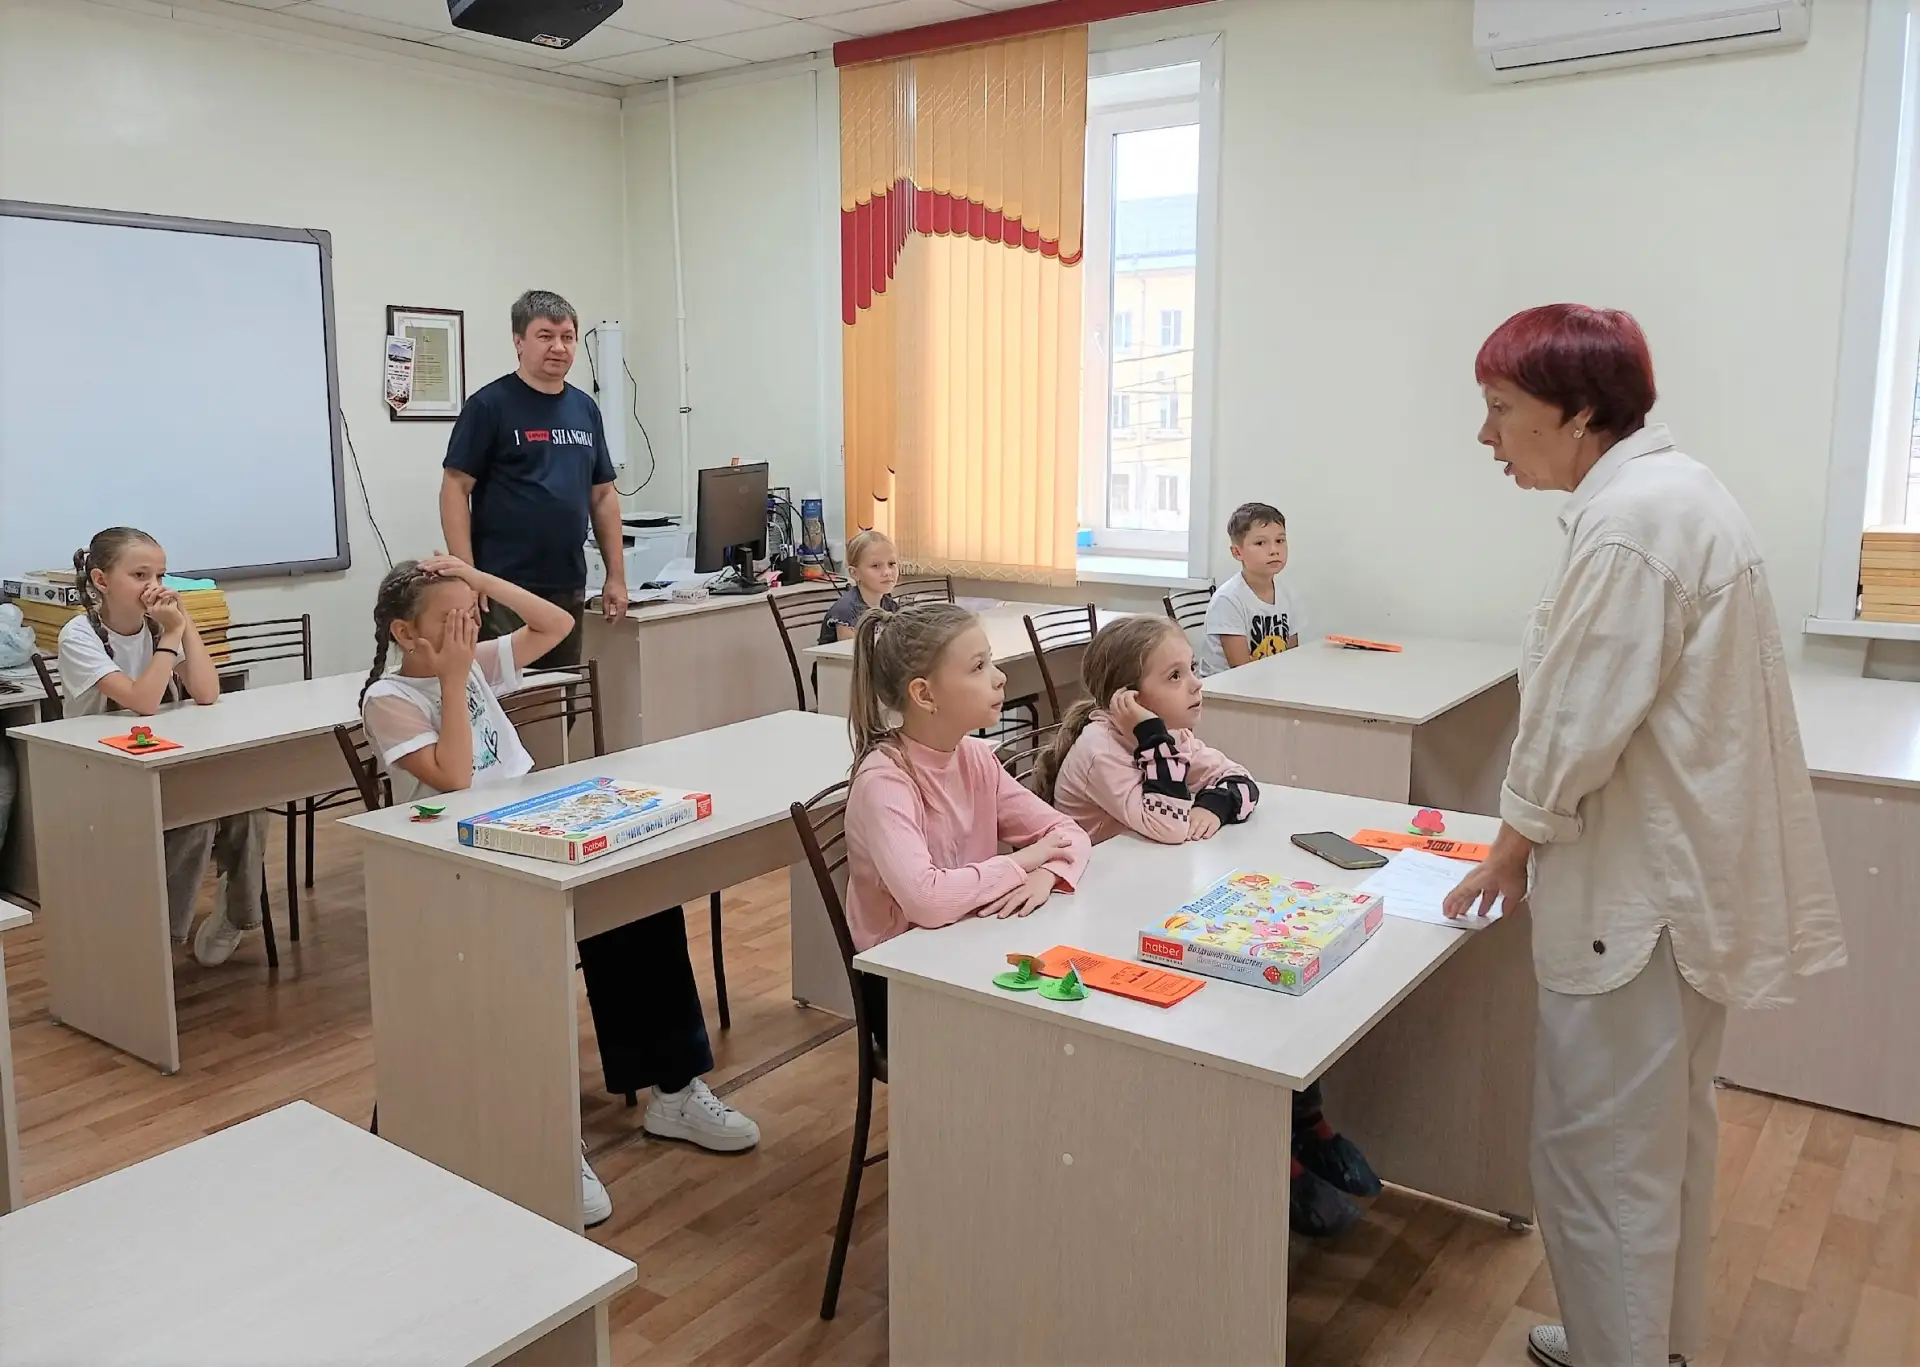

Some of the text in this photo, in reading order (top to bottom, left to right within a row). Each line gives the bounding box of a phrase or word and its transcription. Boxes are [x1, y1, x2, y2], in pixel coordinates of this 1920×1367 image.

[513, 429, 521, 446] I
[583, 838, 607, 854] hatber
[1145, 940, 1180, 957] hatber
